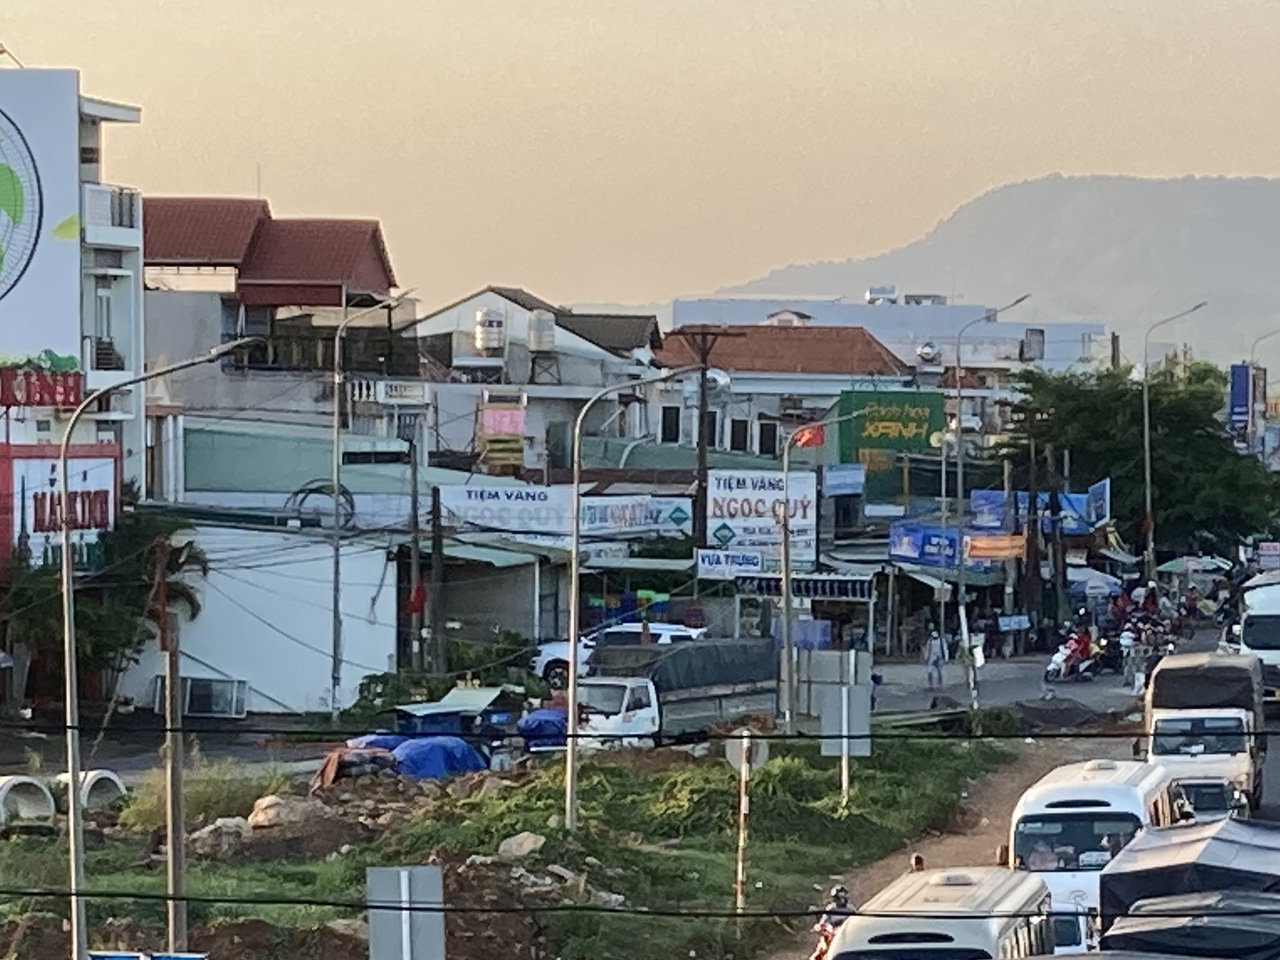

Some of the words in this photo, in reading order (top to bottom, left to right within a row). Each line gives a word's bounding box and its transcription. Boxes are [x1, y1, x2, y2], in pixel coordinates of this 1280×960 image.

[715, 475, 746, 492] TIỆM
[466, 488, 501, 502] TIỆM
[712, 498, 766, 520] NGỌC
